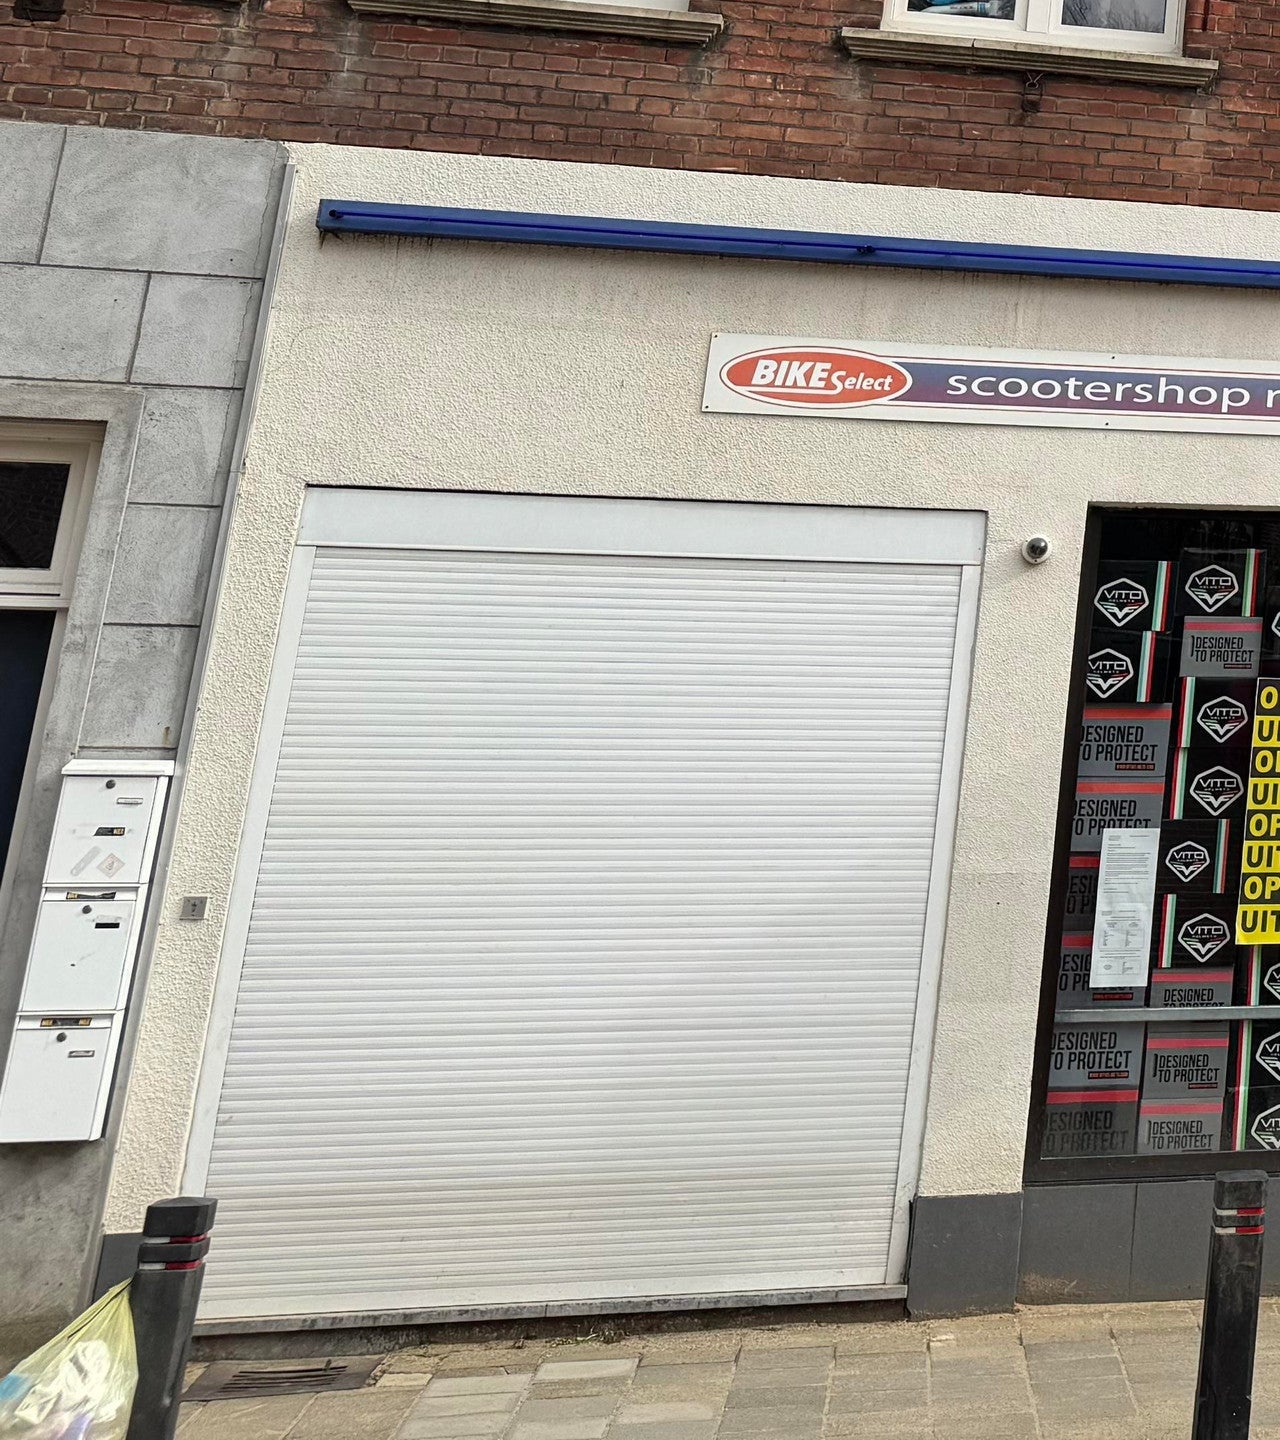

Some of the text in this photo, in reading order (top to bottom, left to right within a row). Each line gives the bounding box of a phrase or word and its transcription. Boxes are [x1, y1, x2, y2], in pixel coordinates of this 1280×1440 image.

[751, 359, 831, 388] BIKE
[831, 370, 893, 395] Select
[947, 375, 1250, 413] scootershop
[1196, 576, 1230, 585] VITO
[1104, 589, 1140, 599] VITO
[1195, 637, 1243, 649] DESIGNED
[1195, 650, 1254, 663] TO PROTECT
[1088, 660, 1126, 670] VITO
[1206, 707, 1240, 716] VITO
[1096, 744, 1158, 761] PROTECT
[1199, 777, 1237, 787] VITO
[1188, 925, 1222, 934] VITO
[1164, 988, 1214, 1002] DESIGNED
[1068, 1051, 1132, 1070] PROTECT
[1159, 1054, 1209, 1068] DESIGNED
[1159, 1068, 1220, 1082] TO PROTECT
[1152, 1120, 1203, 1135] DESIGNED
[1152, 1134, 1213, 1149] TO PROTECT
